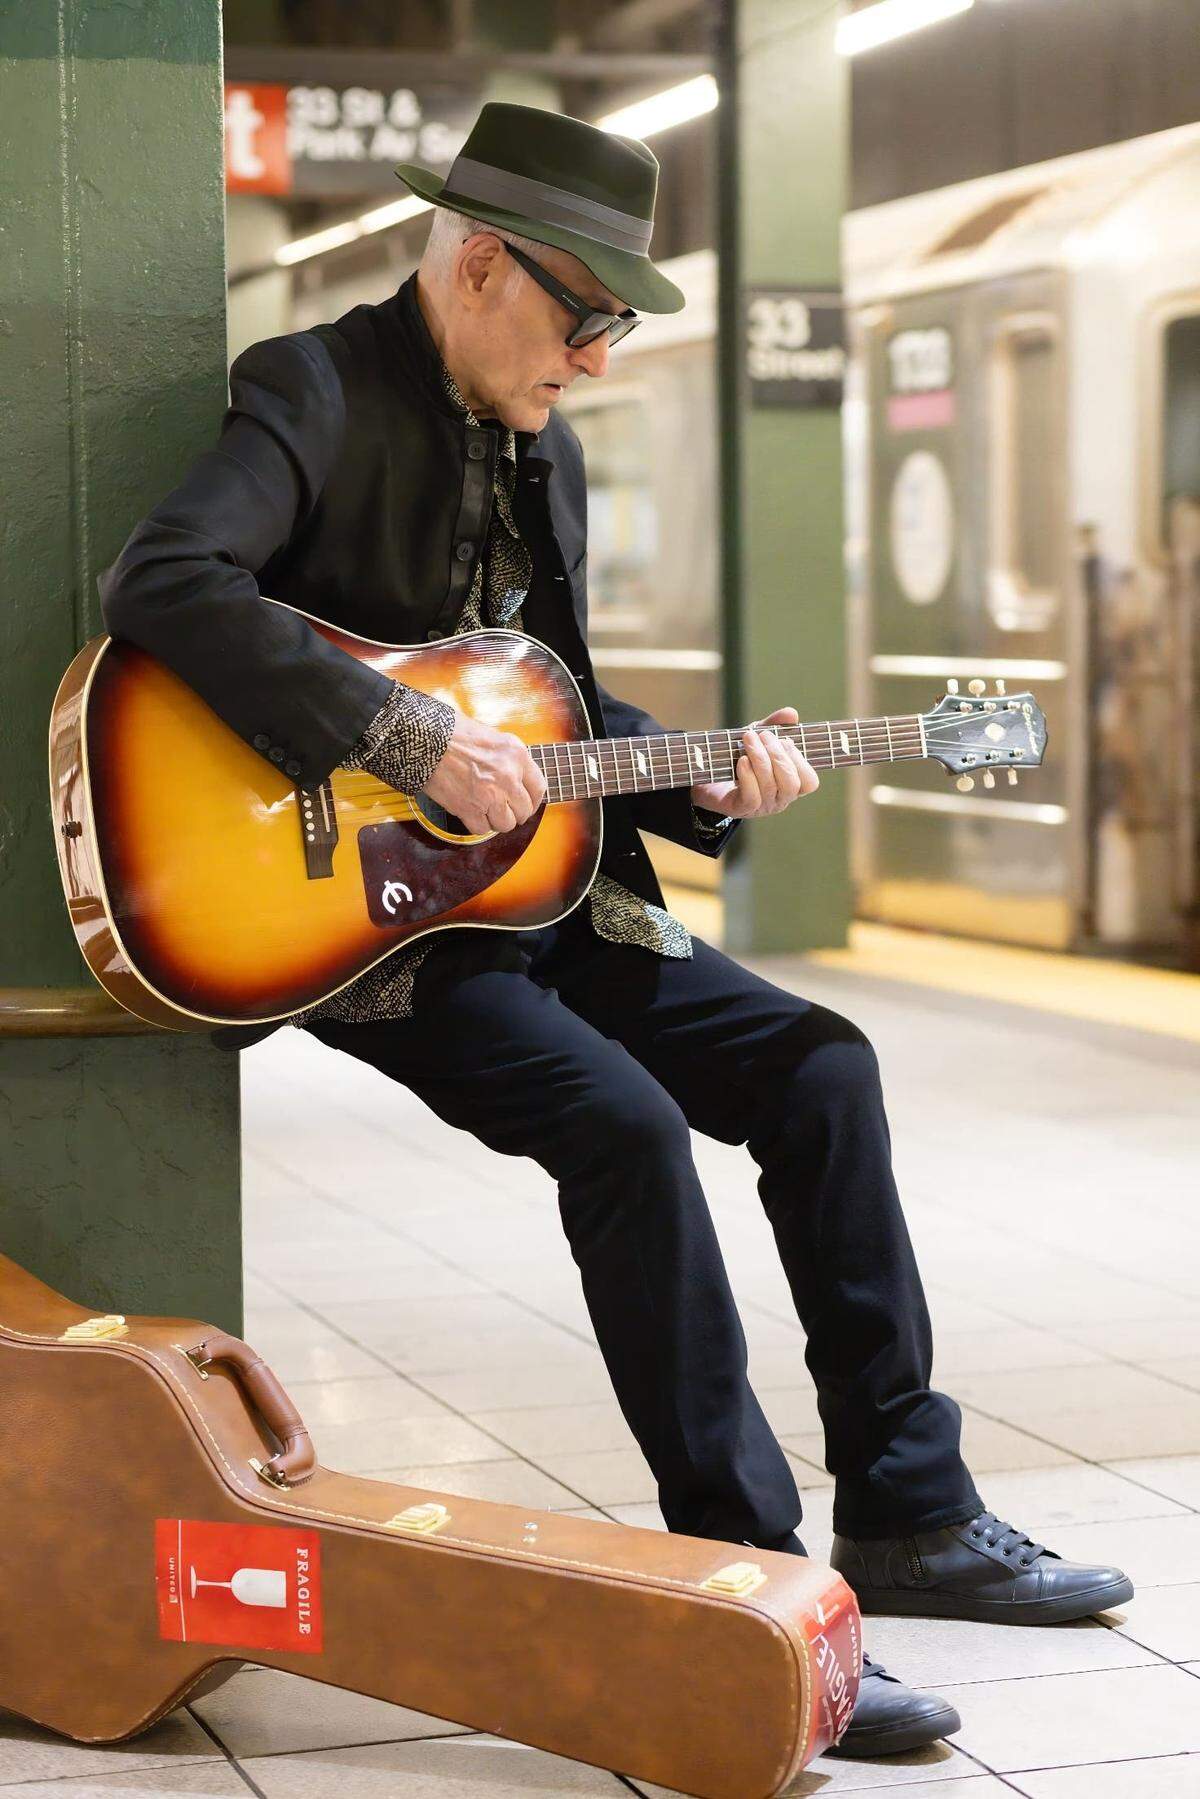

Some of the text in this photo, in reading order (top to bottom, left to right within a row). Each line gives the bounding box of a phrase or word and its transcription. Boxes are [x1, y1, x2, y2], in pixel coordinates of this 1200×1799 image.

[286, 87, 338, 127] 33
[286, 126, 364, 160] Park
[749, 299, 811, 348] 33
[749, 348, 845, 380] Street
[168, 1557, 177, 1593] UNITED
[296, 1548, 311, 1635] FRAGILE
